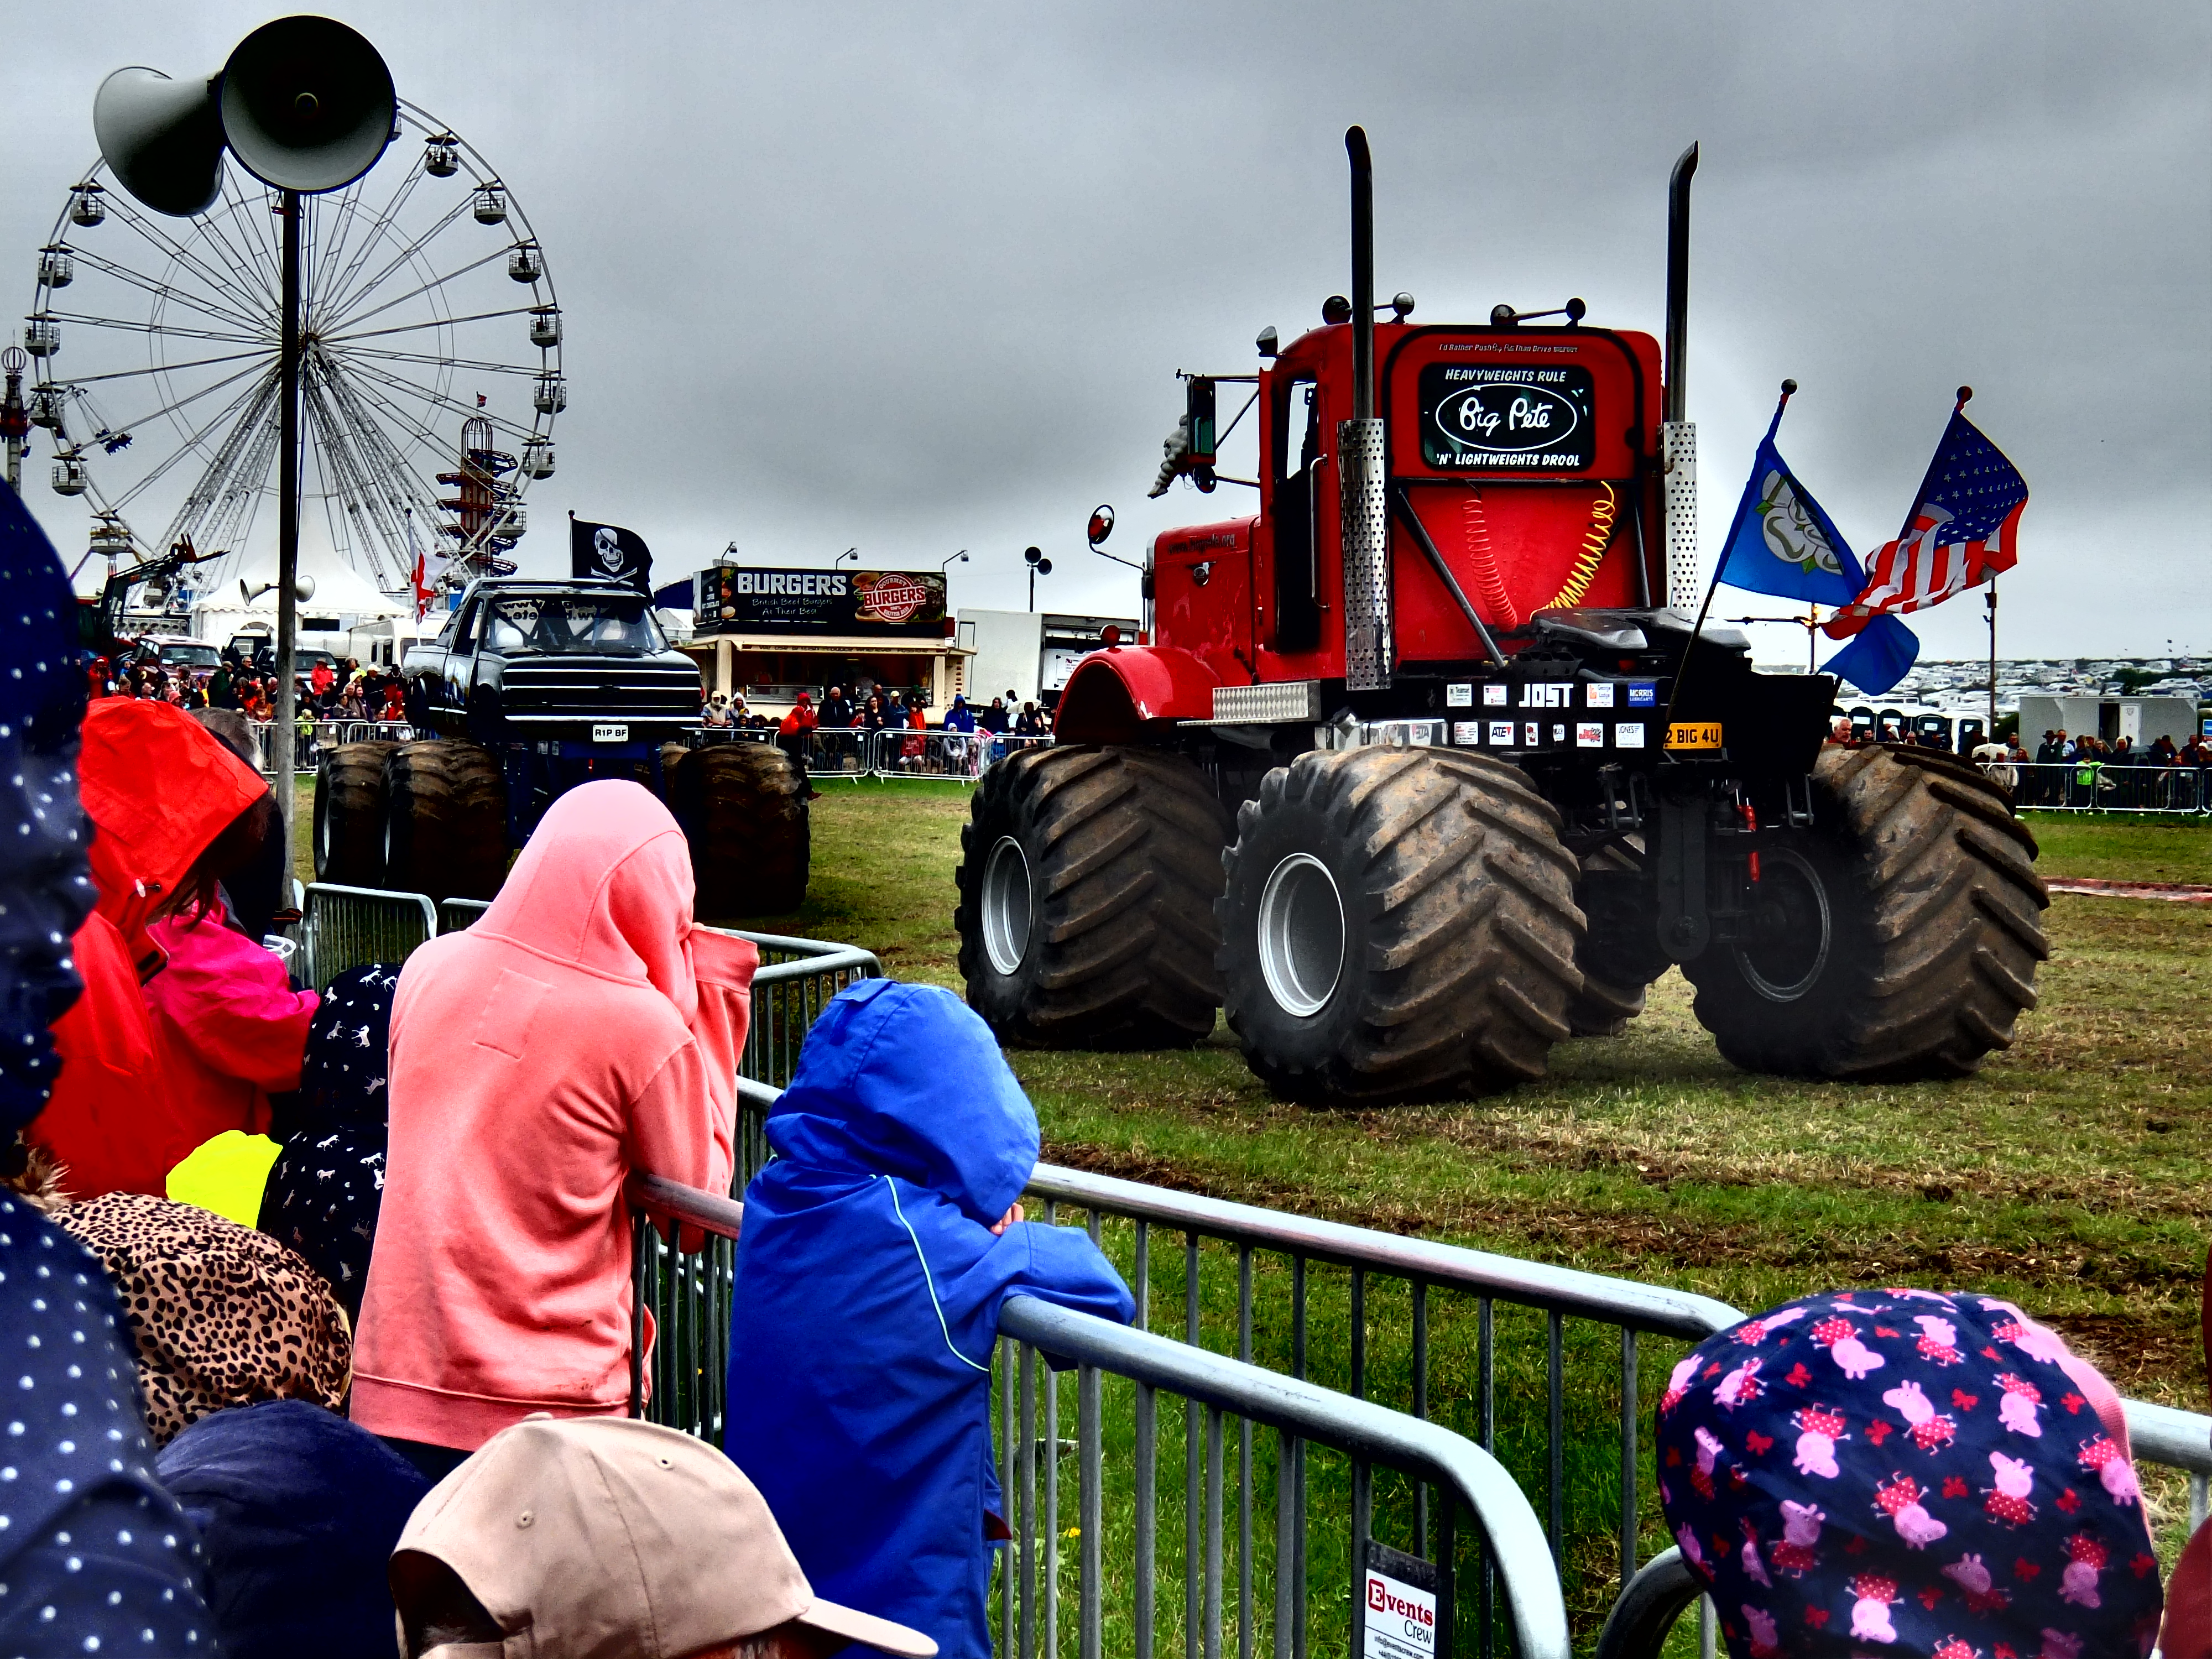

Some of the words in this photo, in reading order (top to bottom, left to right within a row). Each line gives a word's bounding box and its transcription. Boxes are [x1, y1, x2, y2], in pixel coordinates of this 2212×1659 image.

[1445, 369, 1535, 382] HEAVYWEIGHTS
[1537, 371, 1567, 382] RULE
[1458, 397, 1501, 436] Big
[1509, 397, 1553, 431] Pete
[1436, 453, 1452, 465] 'N'
[1455, 453, 1540, 466] LIGHTWEIGHTS
[1542, 455, 1580, 466] DROOL
[738, 573, 846, 596] BURGERS
[879, 577, 907, 589] GOURMET
[803, 598, 833, 607] Burgers
[864, 587, 926, 606] BURGERS
[1519, 683, 1574, 707] JOST
[1491, 727, 1507, 737] ATE
[1619, 726, 1634, 734] JONES
[1665, 729, 1673, 743] 2
[1677, 729, 1698, 743] BIG
[1702, 729, 1719, 743] 4U
[1369, 1579, 1433, 1626] Events
[1404, 1620, 1432, 1644] Crew
